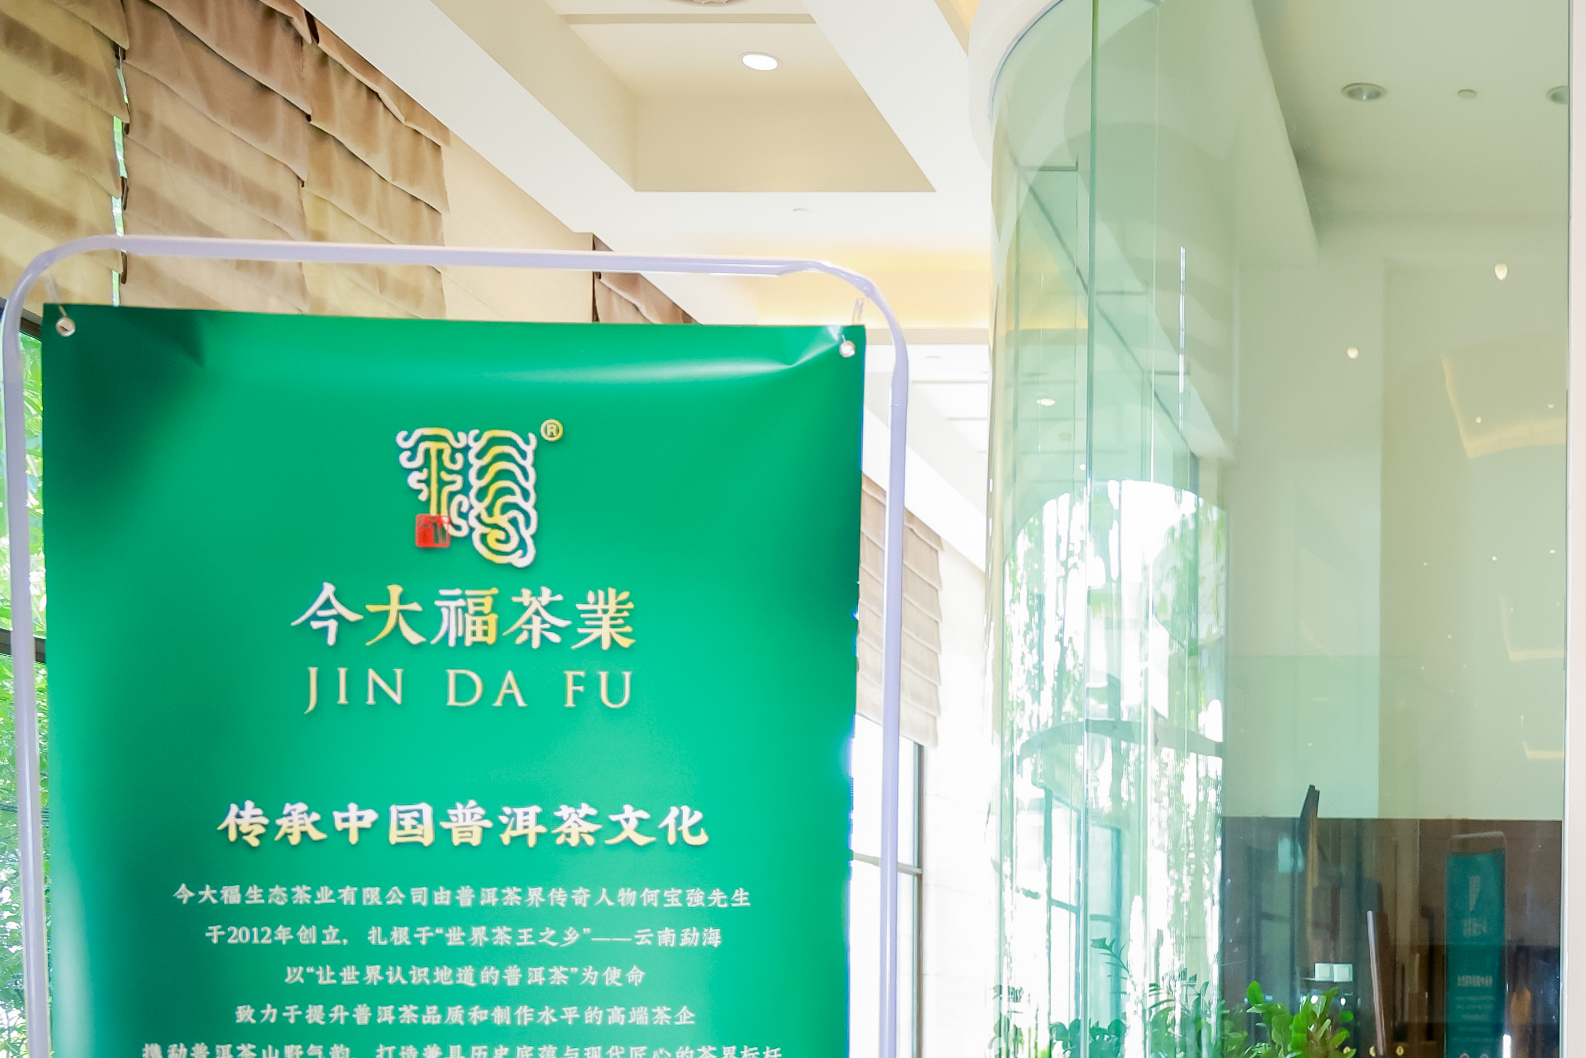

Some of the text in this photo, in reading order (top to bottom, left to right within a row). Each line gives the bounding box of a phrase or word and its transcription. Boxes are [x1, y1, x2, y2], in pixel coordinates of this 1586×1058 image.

[291, 580, 637, 651] 今大福茶業
[304, 665, 634, 714] JIN DA FU
[217, 798, 710, 849] 传承中国普洱茶文化
[234, 1003, 697, 1028] 致力于提升普洱茶品质和制作水平的高端茶企
